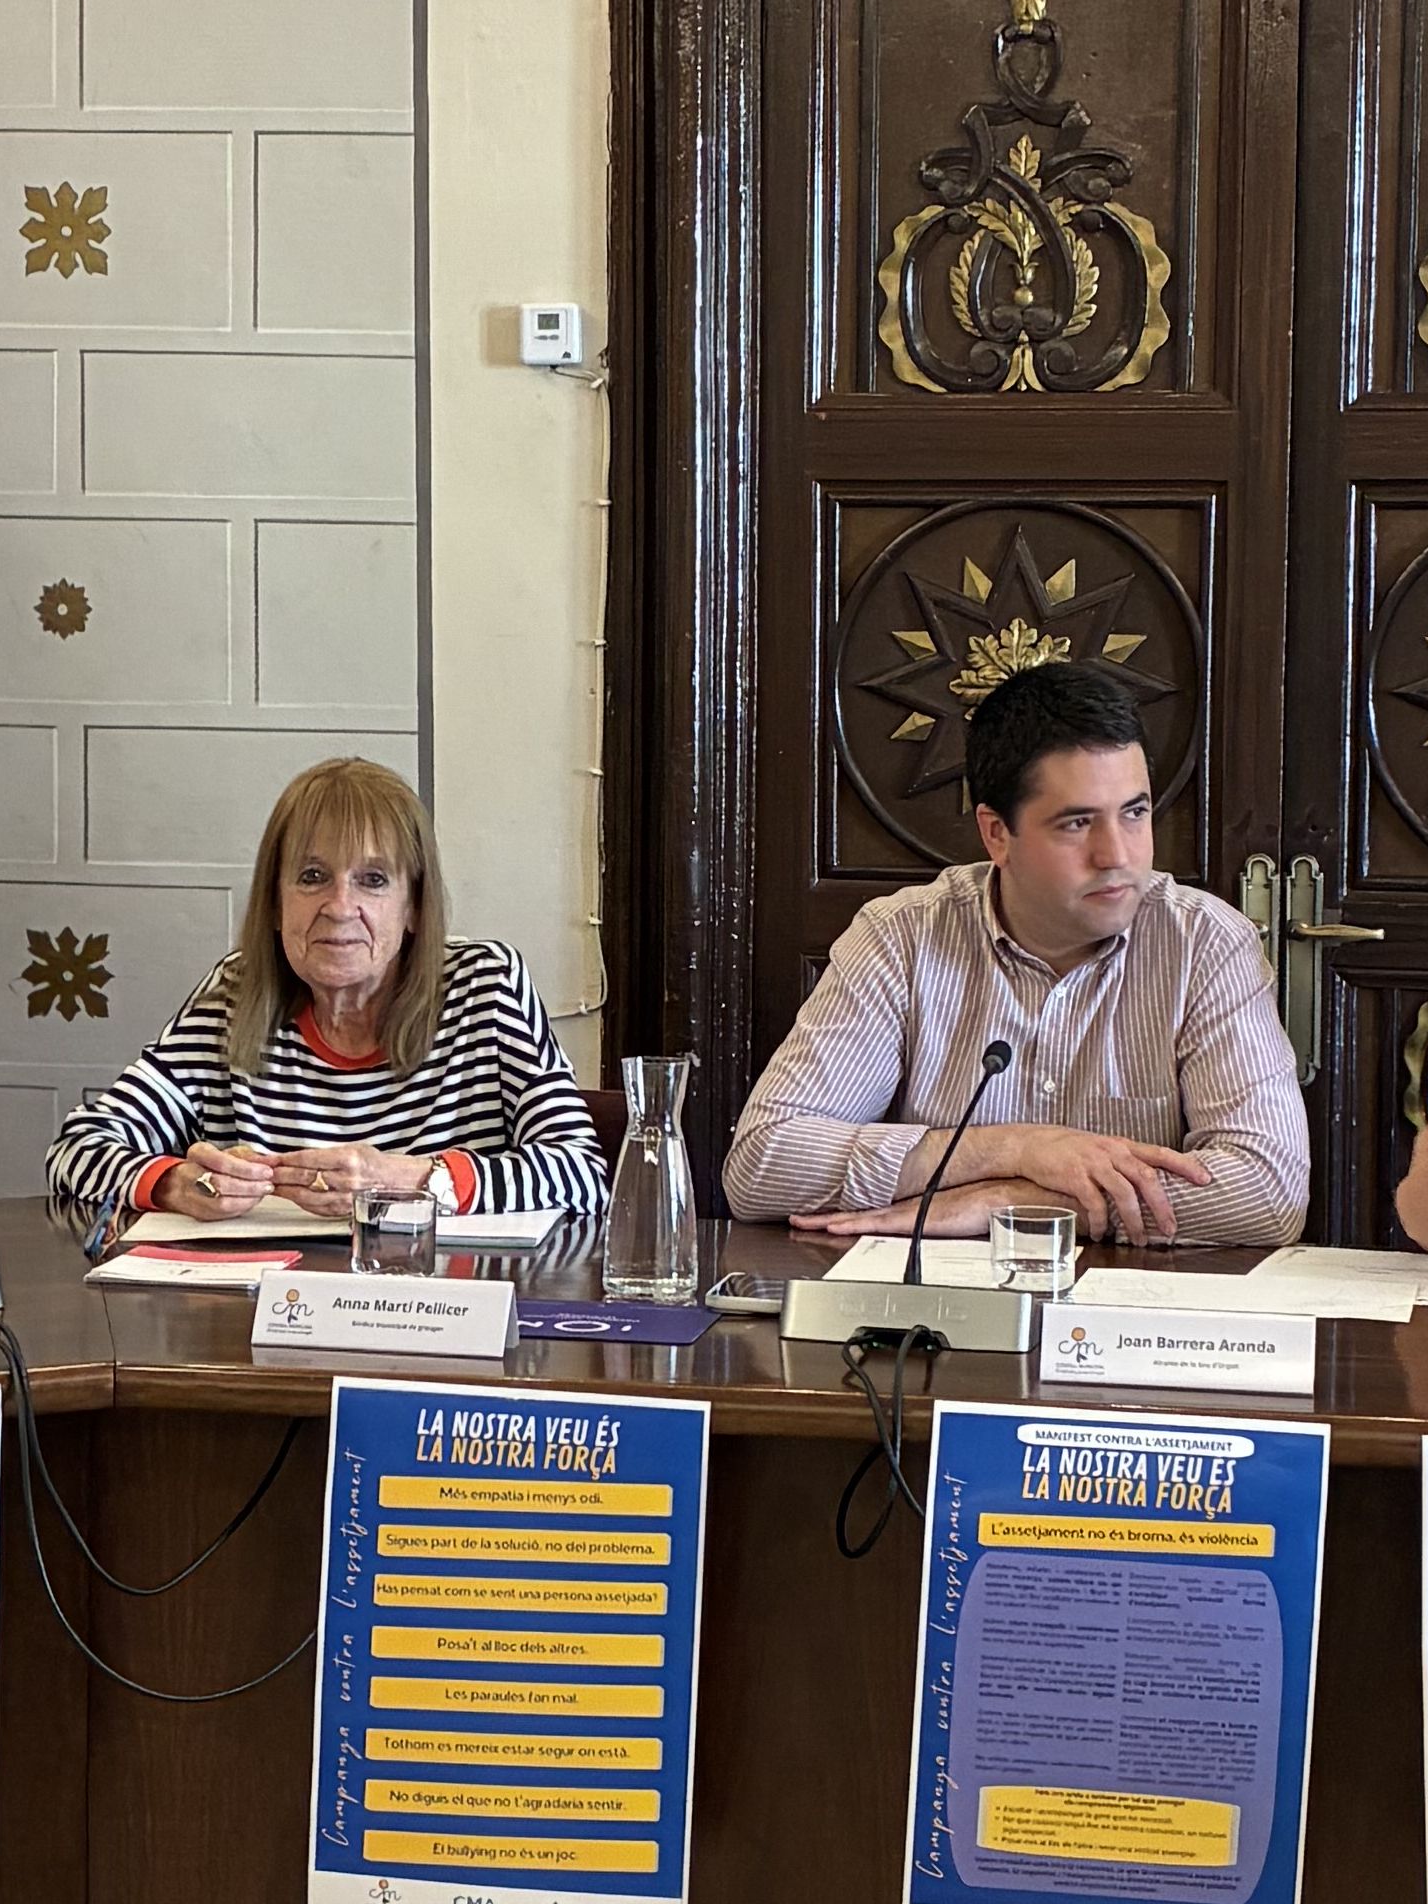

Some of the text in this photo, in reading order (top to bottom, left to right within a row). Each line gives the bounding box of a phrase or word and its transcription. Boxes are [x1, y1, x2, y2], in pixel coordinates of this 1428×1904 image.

[332, 1297, 469, 1316] Anna Martí Pellicer
[1116, 1333, 1275, 1353] Joan Barrera Aranda
[416, 1408, 620, 1448] LA NOSTRA VEU ÉS
[1035, 1430, 1232, 1451] MANIFEST CONTRA L'ASSETJAMENT
[416, 1437, 615, 1480] LA NOSTRA FORÇA
[1022, 1445, 1050, 1475] LA
[1058, 1448, 1147, 1480] NOSTRA
[1157, 1454, 1203, 1483] VEU
[1021, 1474, 1231, 1520] LA NOSTRA FORÇA
